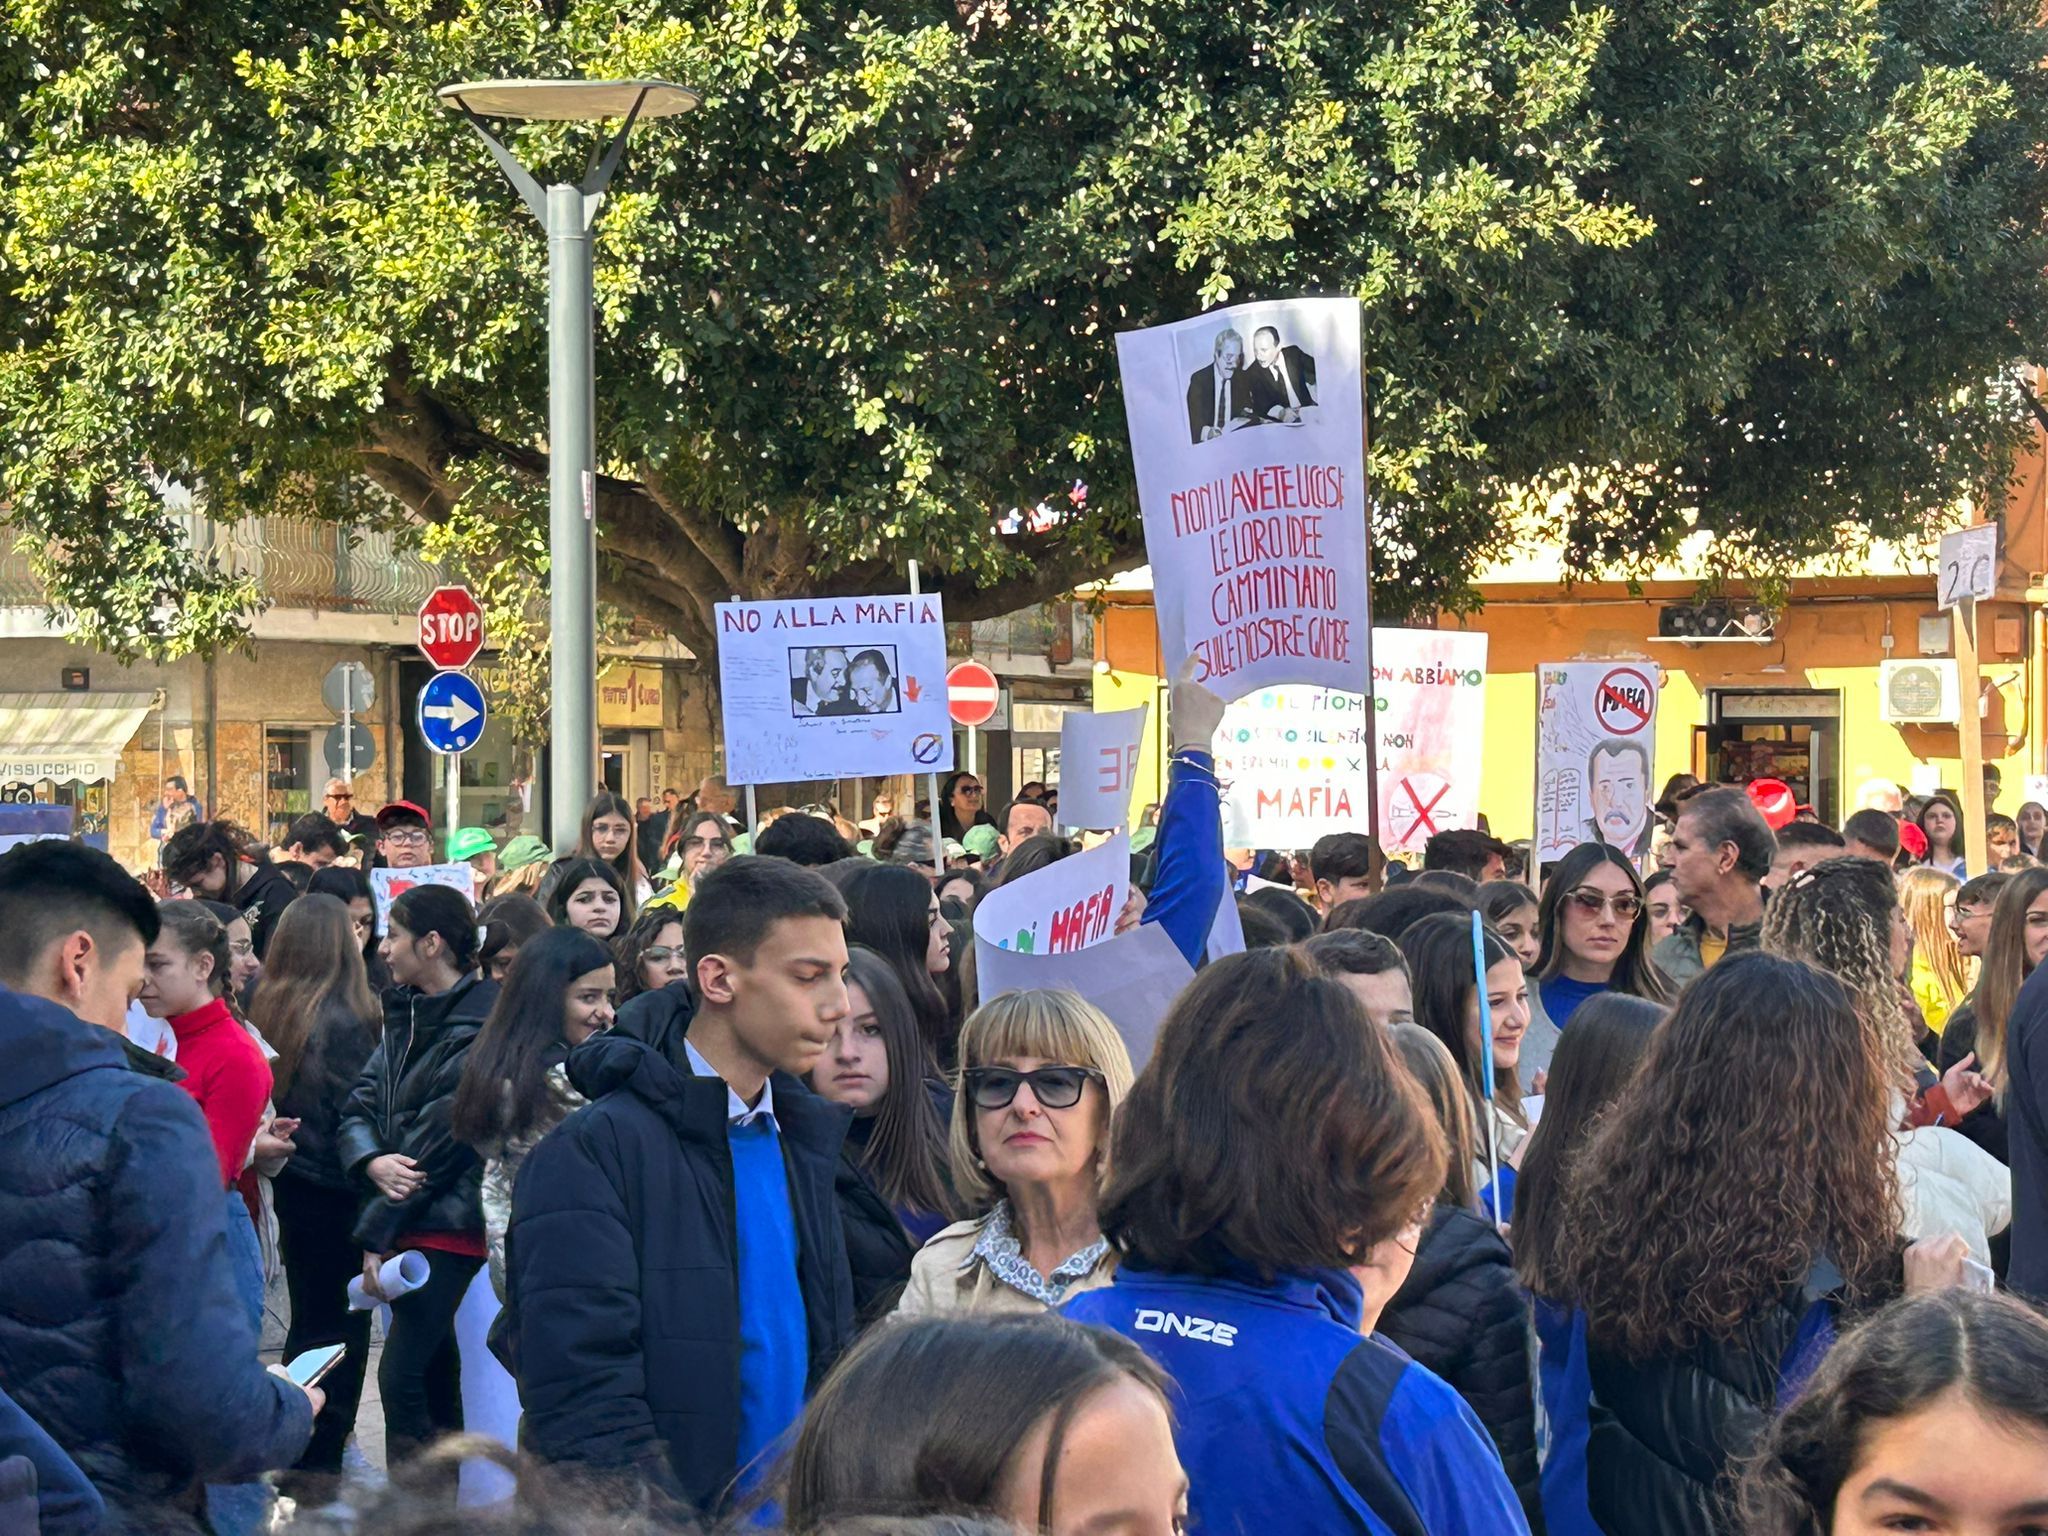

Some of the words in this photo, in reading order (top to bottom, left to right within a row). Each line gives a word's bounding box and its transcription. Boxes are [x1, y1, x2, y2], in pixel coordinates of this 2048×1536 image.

[1171, 483, 1214, 538] NON
[1214, 478, 1229, 525] LI
[1231, 465, 1297, 519] AVETE
[1210, 529, 1232, 577] LE
[1232, 516, 1282, 568] LORO
[1286, 514, 1325, 559] IDEE
[723, 608, 762, 634] NO
[772, 604, 847, 629] ALLA
[855, 601, 938, 625] MAFIA
[1211, 565, 1336, 627] CAMMINANO
[422, 612, 480, 645] STOP
[1193, 629, 1237, 684] SULLE
[1236, 614, 1306, 669] NOSTRE
